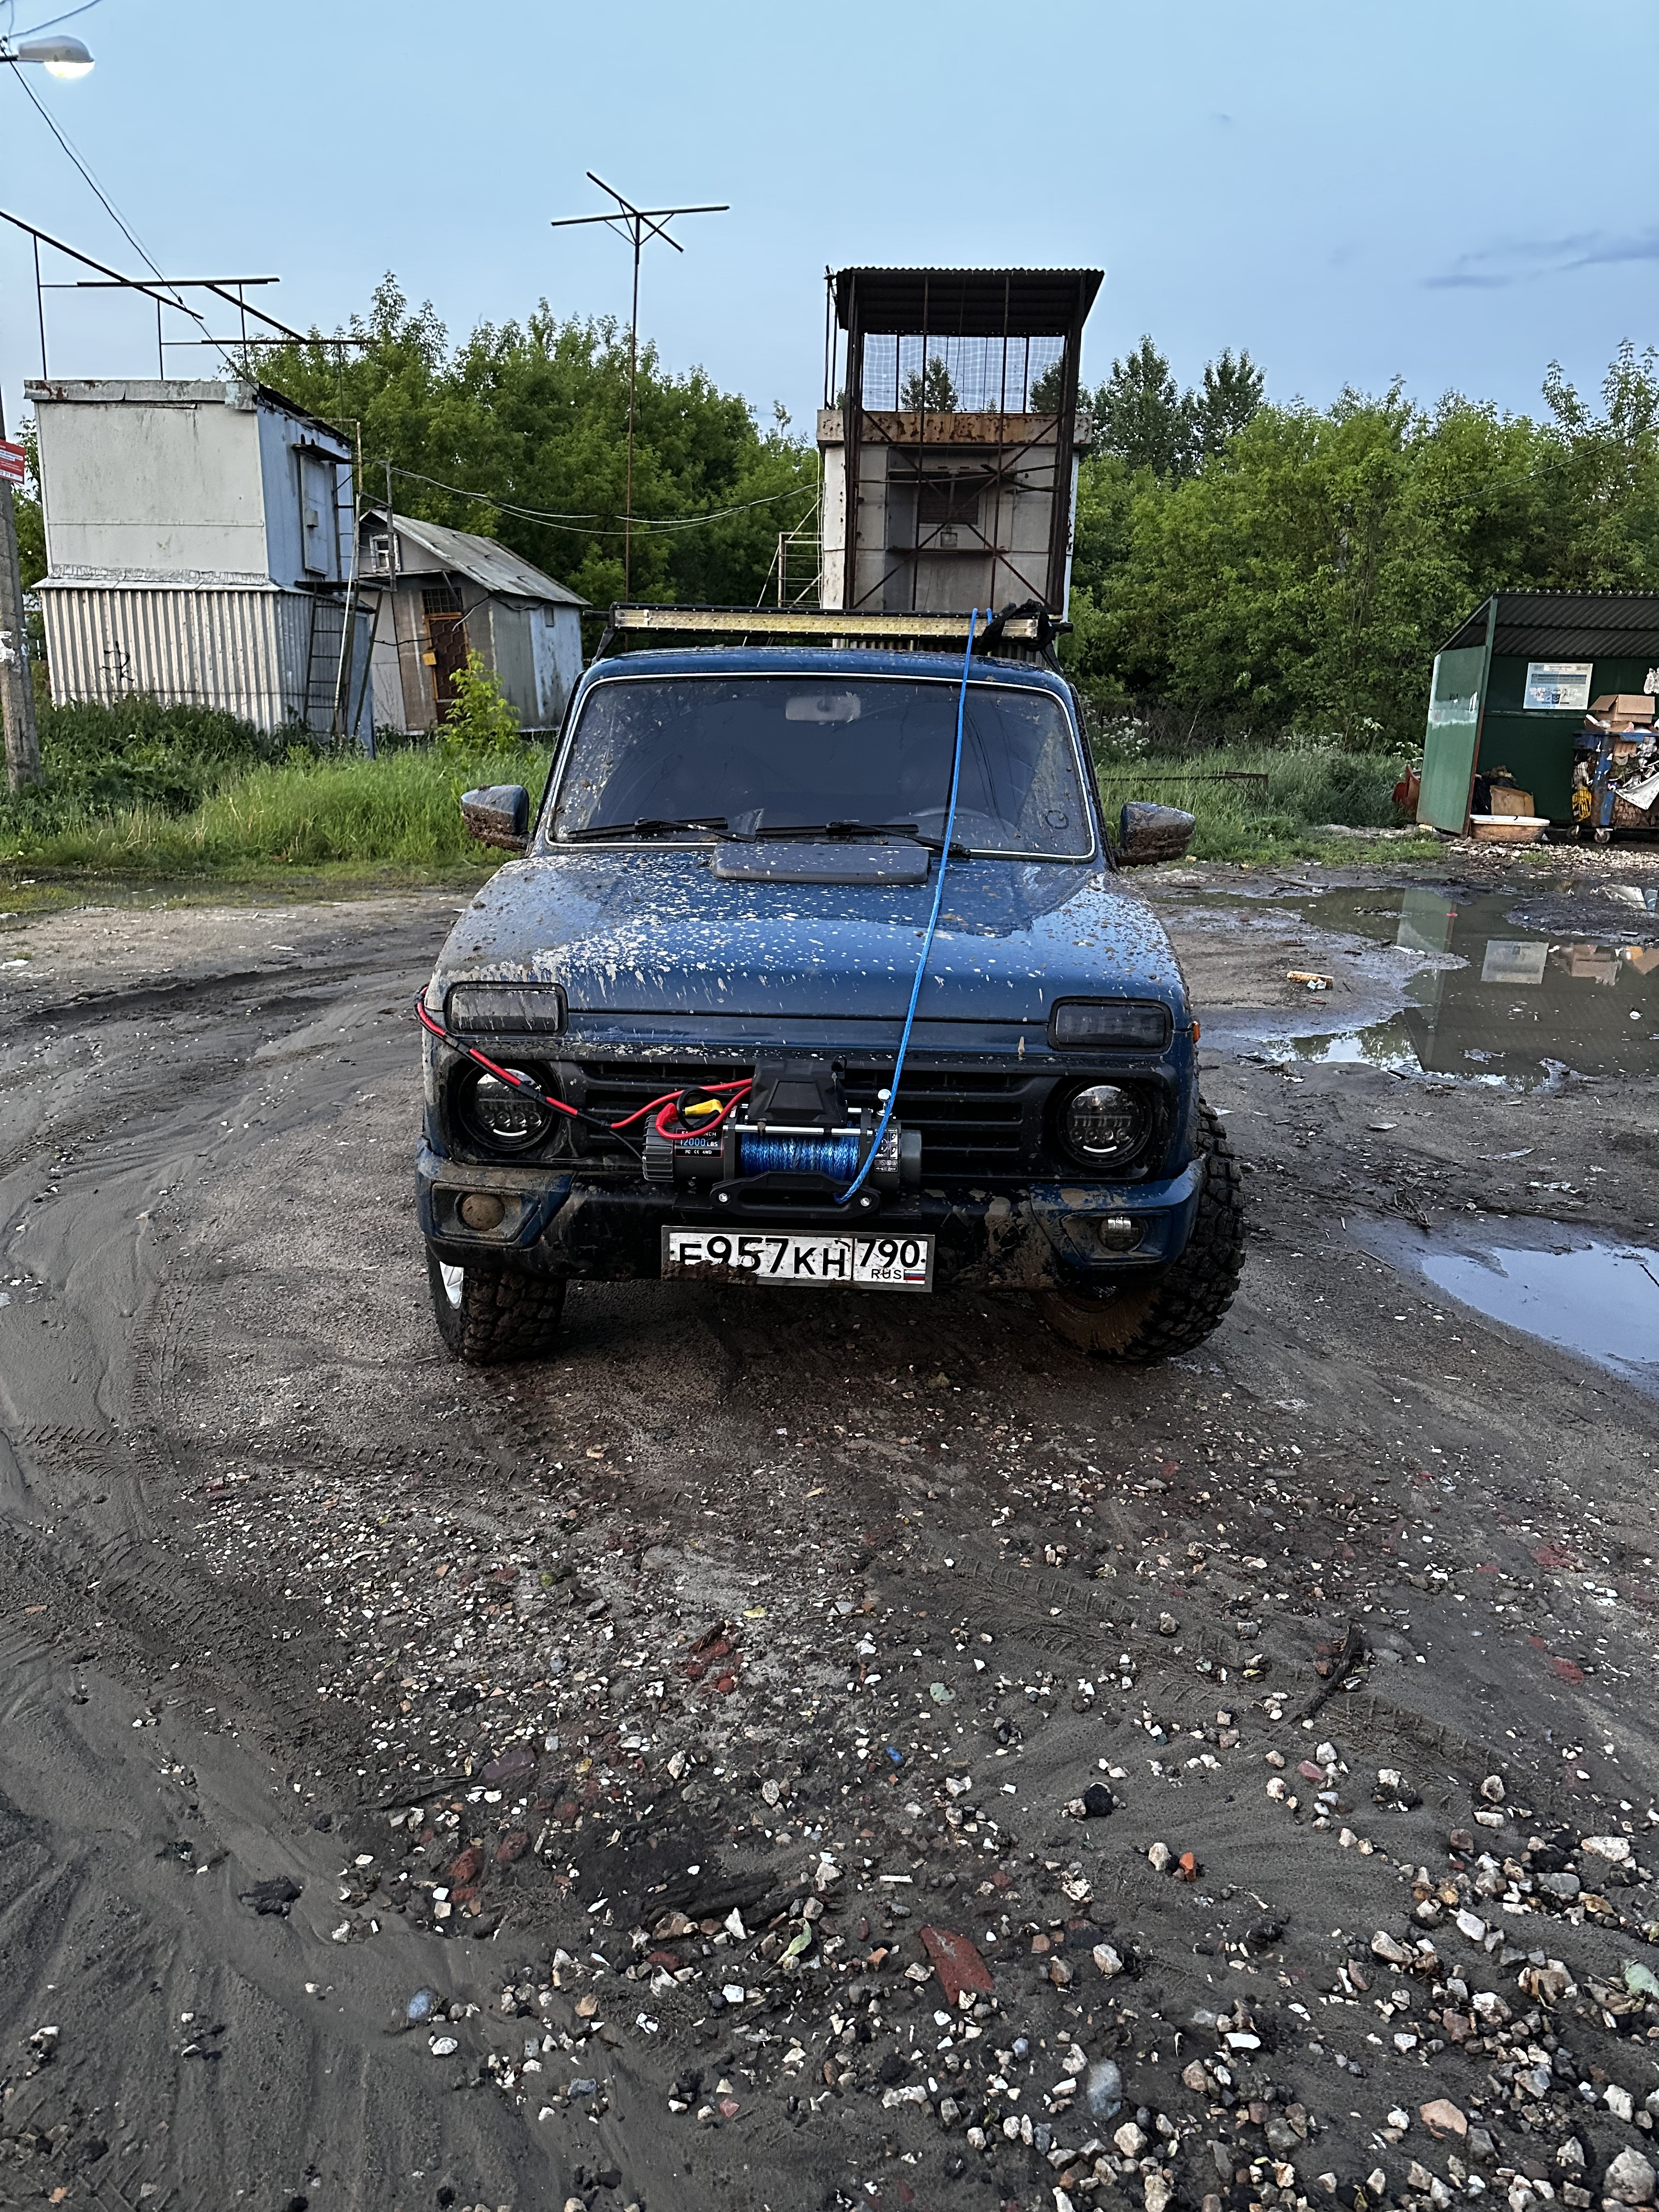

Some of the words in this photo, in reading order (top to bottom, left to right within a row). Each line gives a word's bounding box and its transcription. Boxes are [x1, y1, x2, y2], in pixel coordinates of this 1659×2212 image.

[680, 1138, 706, 1147] 12000
[857, 1238, 920, 1268] 790
[871, 1268, 902, 1279] RUS
